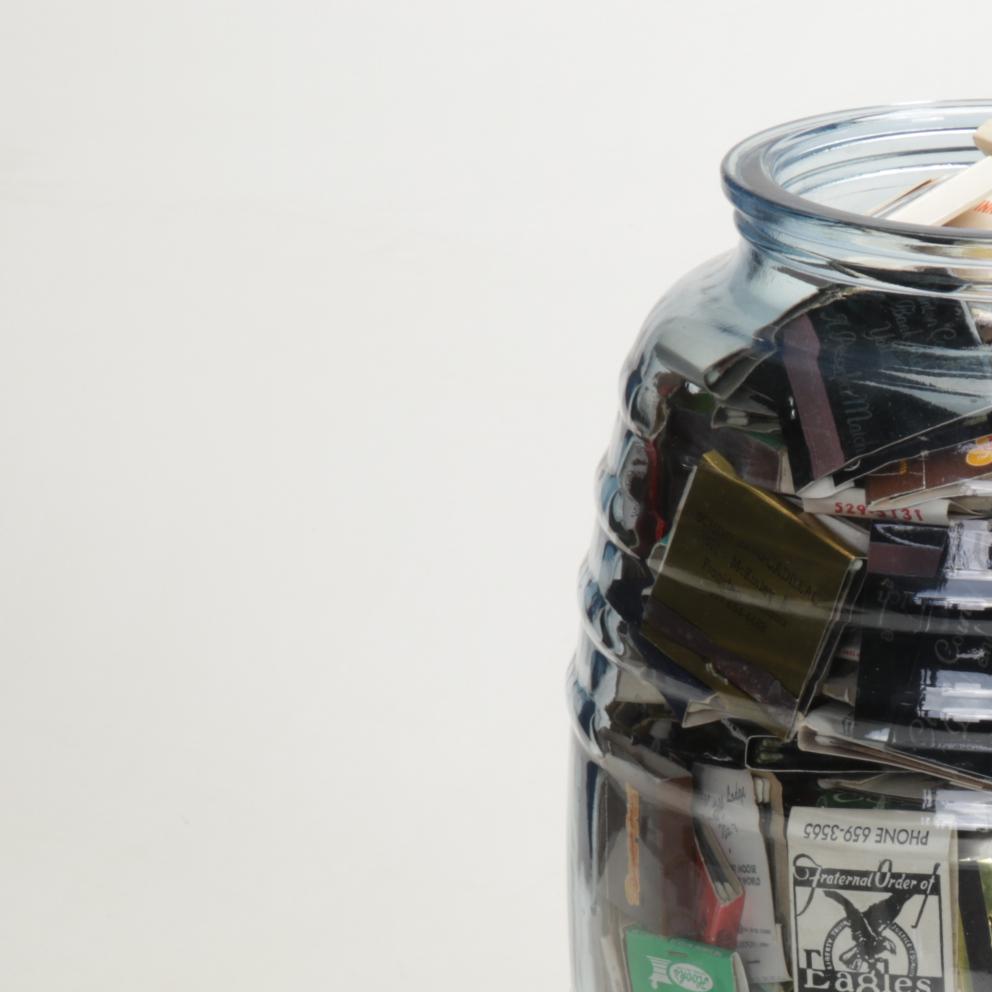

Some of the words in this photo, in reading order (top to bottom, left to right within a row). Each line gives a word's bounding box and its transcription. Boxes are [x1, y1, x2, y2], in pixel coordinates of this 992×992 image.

[803, 823, 871, 843] 659-3565
[875, 828, 930, 846] PHONE
[793, 853, 873, 902] Fraternal
[875, 858, 918, 890] Order
